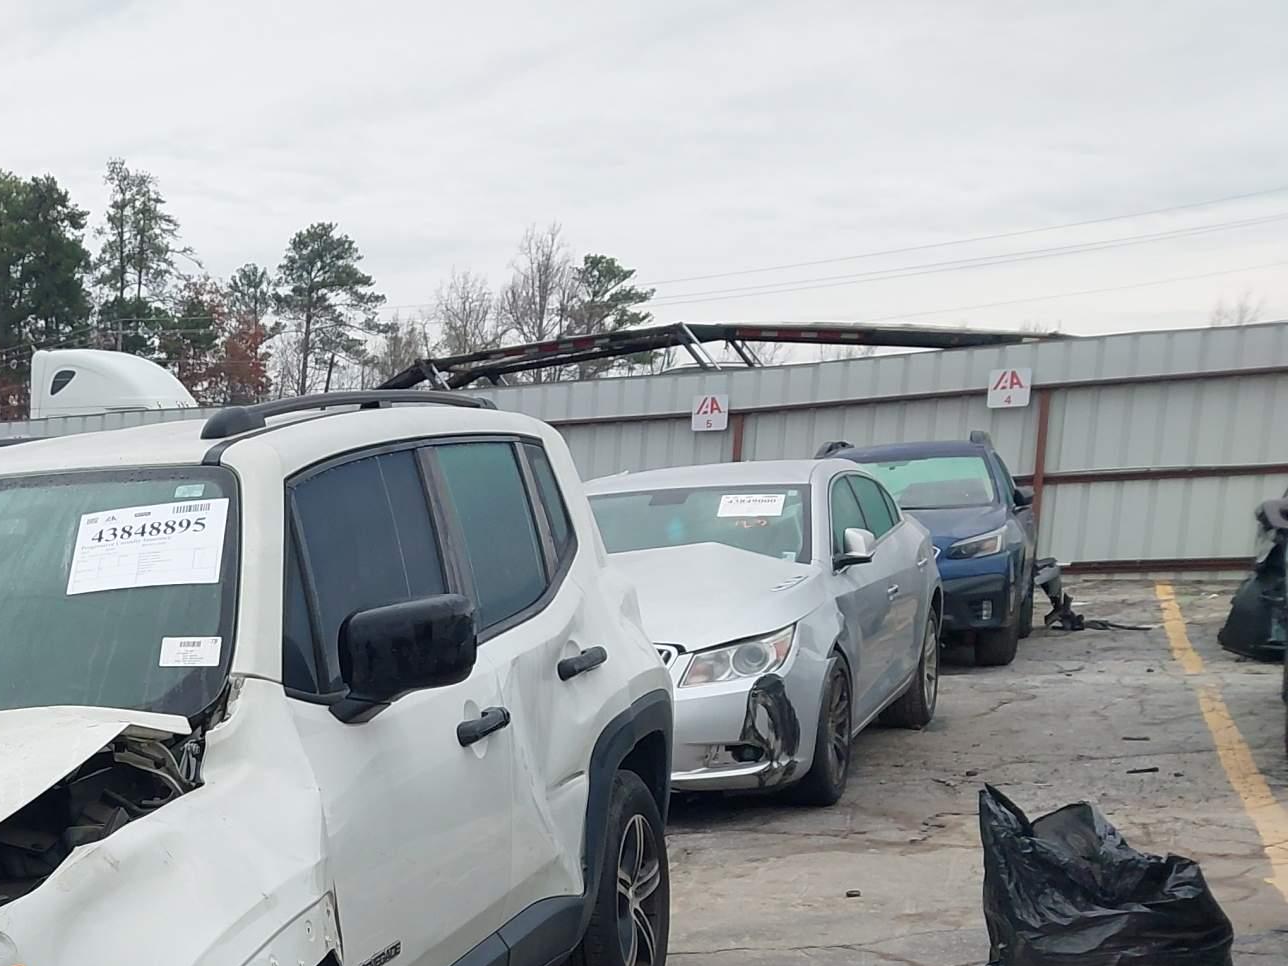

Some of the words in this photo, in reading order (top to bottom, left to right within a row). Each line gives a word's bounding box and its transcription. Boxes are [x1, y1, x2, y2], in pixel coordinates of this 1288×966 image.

[1004, 395, 1012, 405] 4
[706, 419, 713, 428] 5
[91, 516, 207, 543] 43848895
